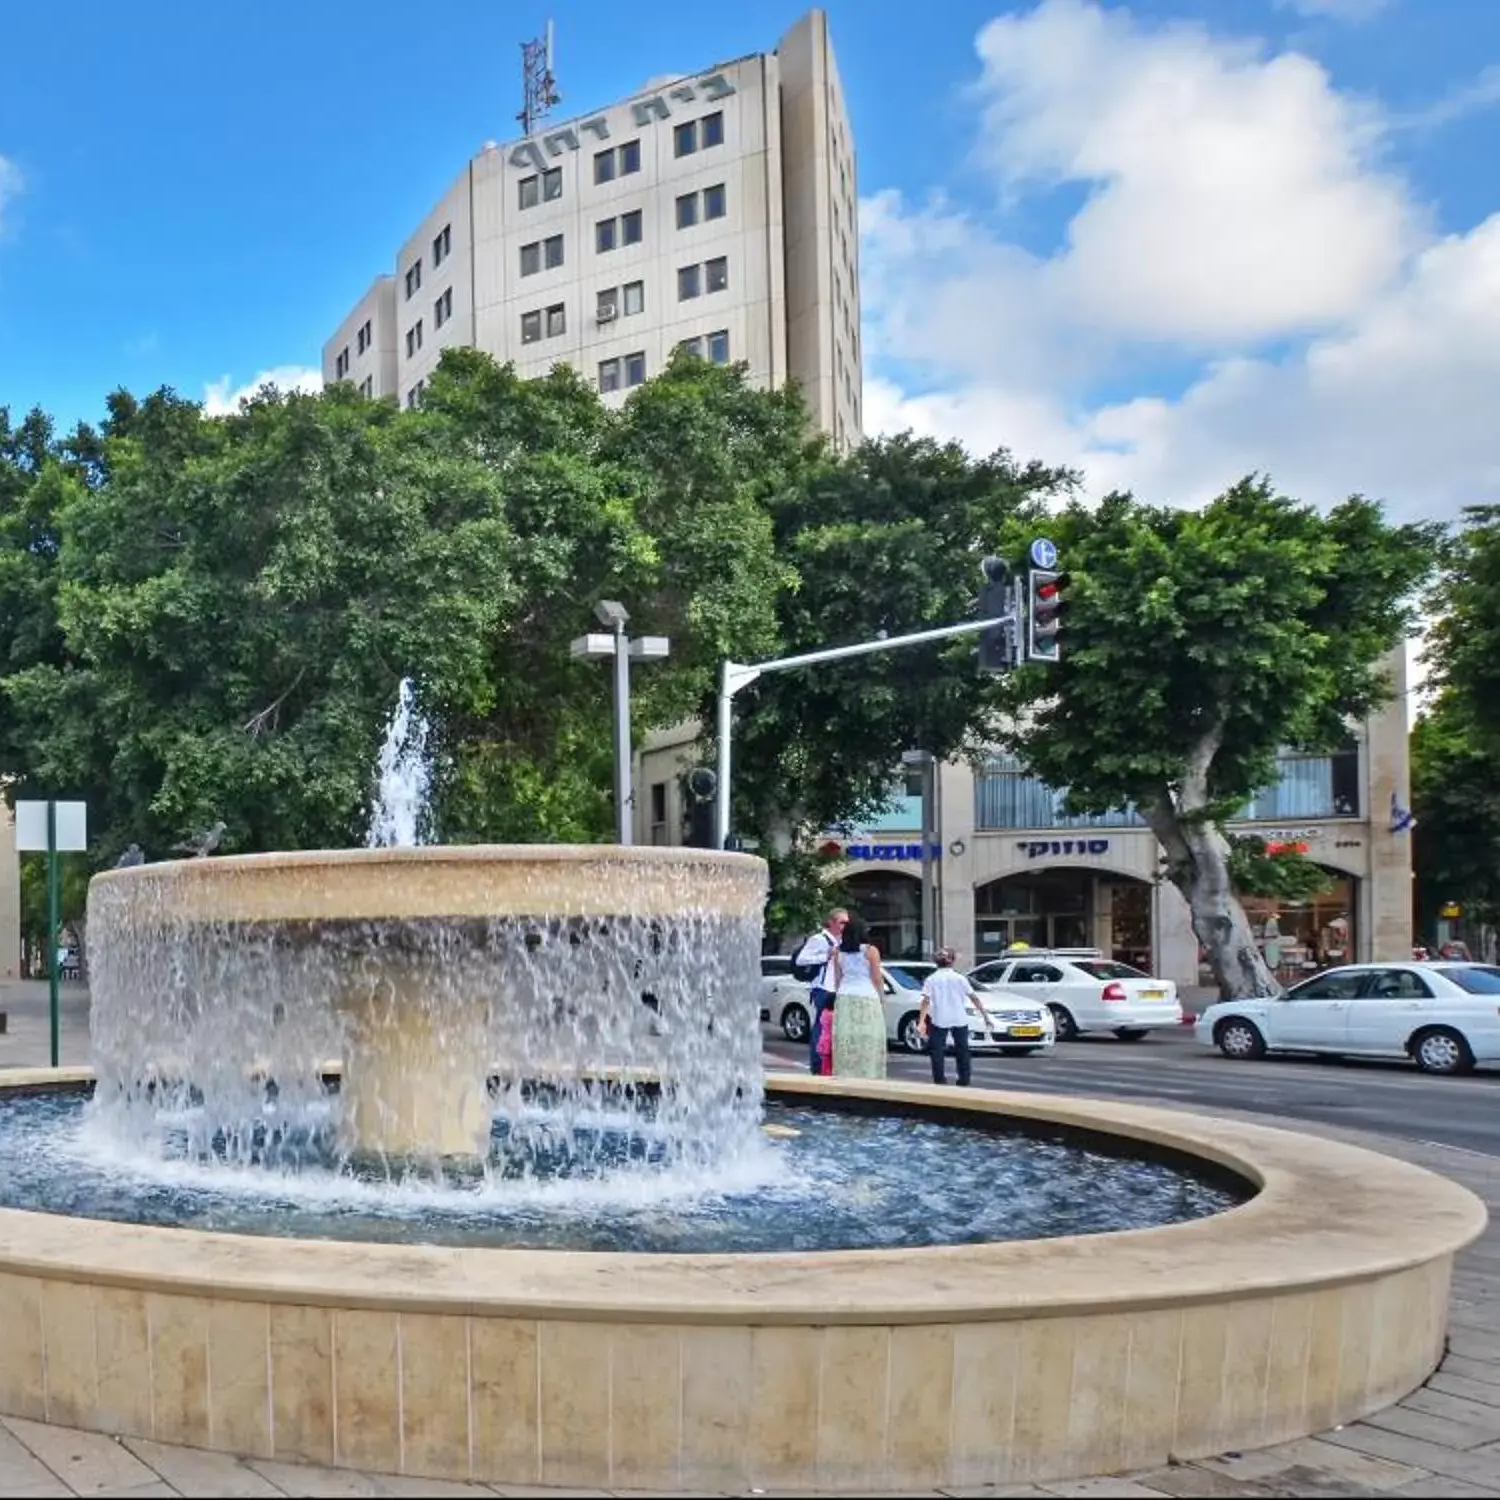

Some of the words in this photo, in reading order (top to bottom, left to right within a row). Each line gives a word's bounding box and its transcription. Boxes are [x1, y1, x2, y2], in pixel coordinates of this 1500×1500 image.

[630, 73, 737, 128] בית
[508, 114, 611, 172] דחף
[1016, 840, 1109, 859] סוזוקי
